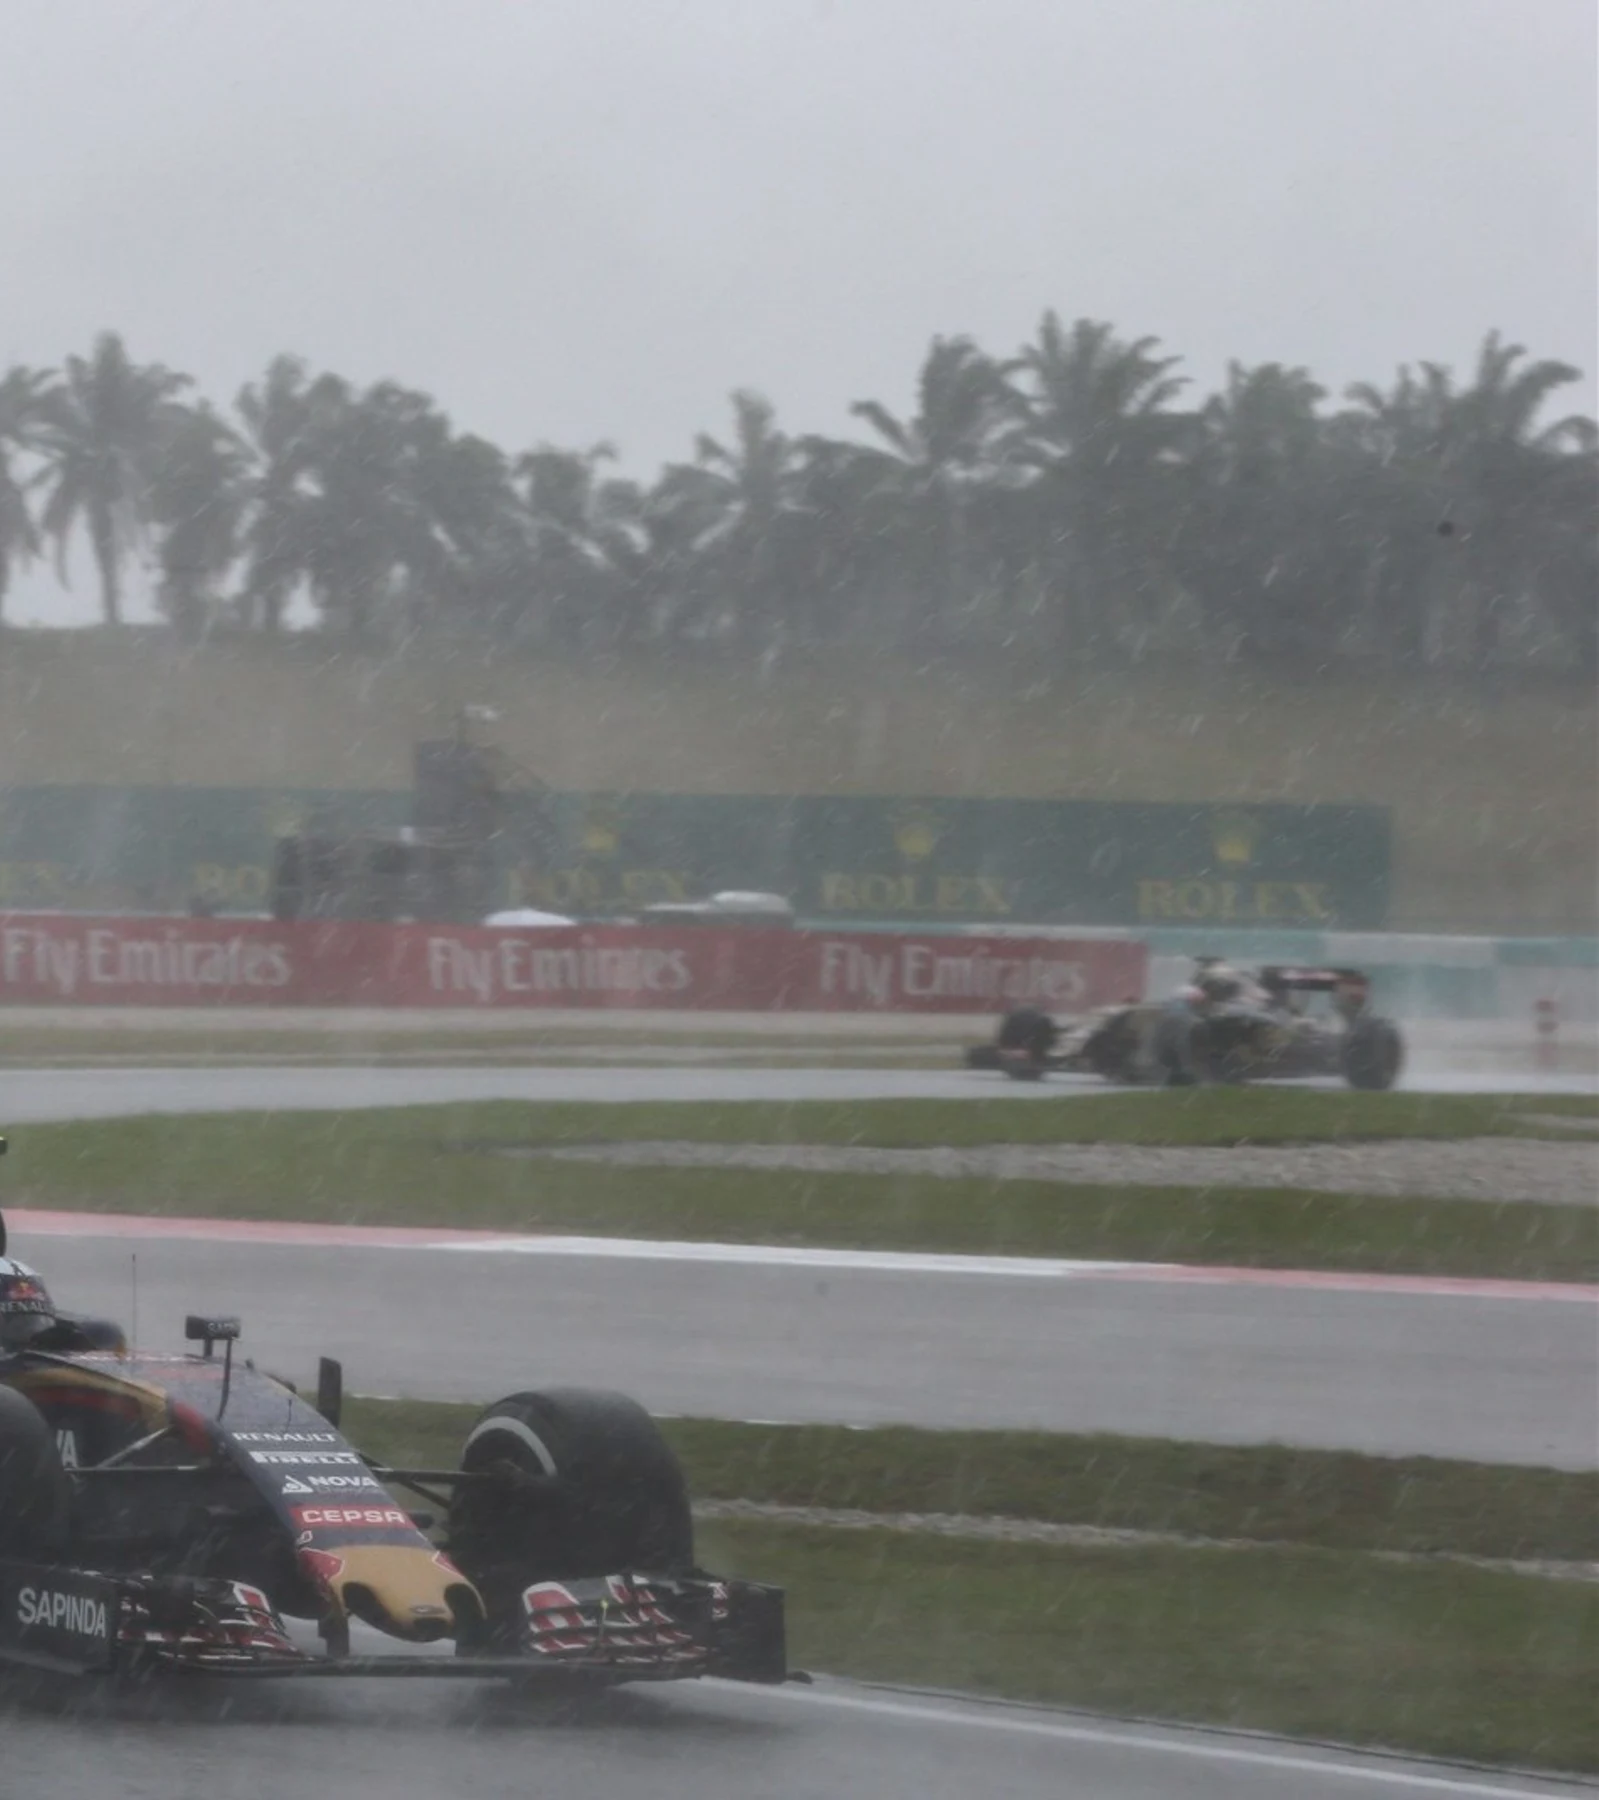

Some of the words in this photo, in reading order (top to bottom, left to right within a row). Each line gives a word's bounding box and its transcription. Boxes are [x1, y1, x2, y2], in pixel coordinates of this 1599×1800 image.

[820, 873, 1011, 915] ROLEX
[1137, 878, 1332, 918] ROLEX
[2, 927, 84, 992] Fly
[86, 927, 292, 984] Emirates
[429, 936, 496, 1000] Fly
[501, 934, 694, 992] Emirates
[821, 938, 898, 1003] Fly
[903, 943, 1088, 1000] Emirates
[232, 1432, 338, 1443] RENAULT
[249, 1450, 360, 1464] PIRELLI
[307, 1476, 379, 1487] NOVA
[300, 1509, 406, 1525] CEPSA
[17, 1586, 106, 1639] SAPINDA
